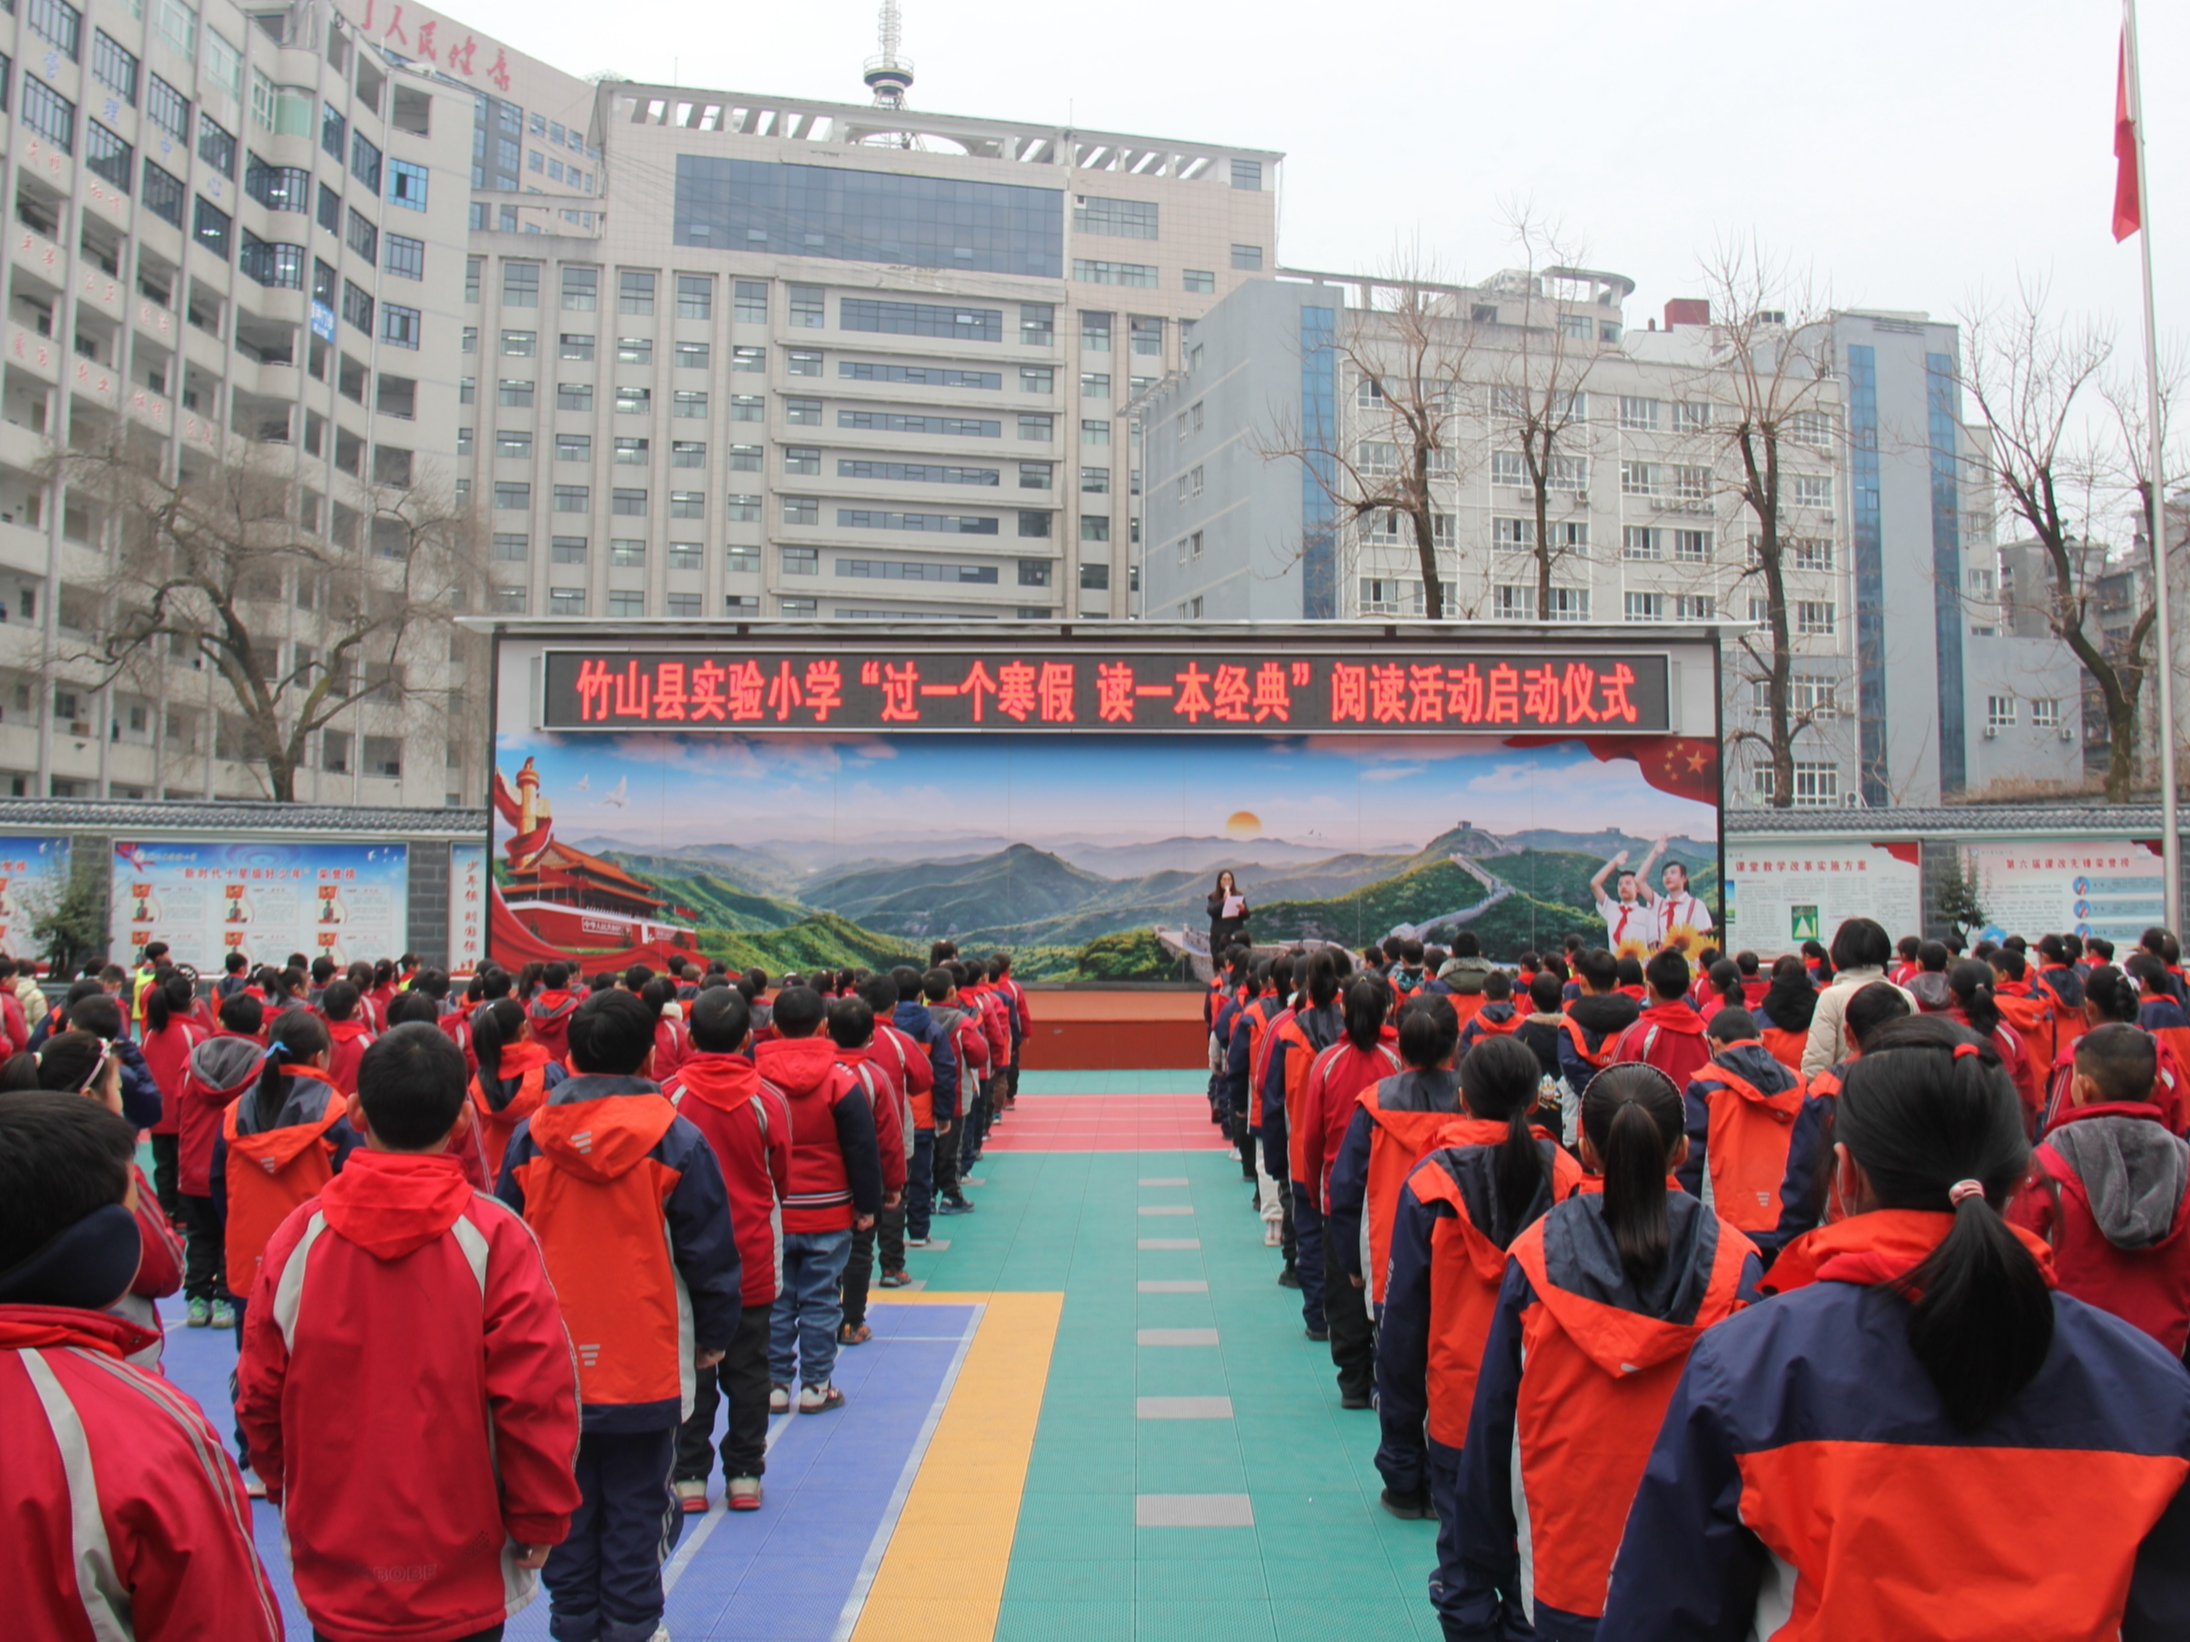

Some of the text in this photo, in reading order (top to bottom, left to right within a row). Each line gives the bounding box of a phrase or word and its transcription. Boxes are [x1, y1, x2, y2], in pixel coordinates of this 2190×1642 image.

[1735, 860, 1867, 873] 课堂教学改革实施方案
